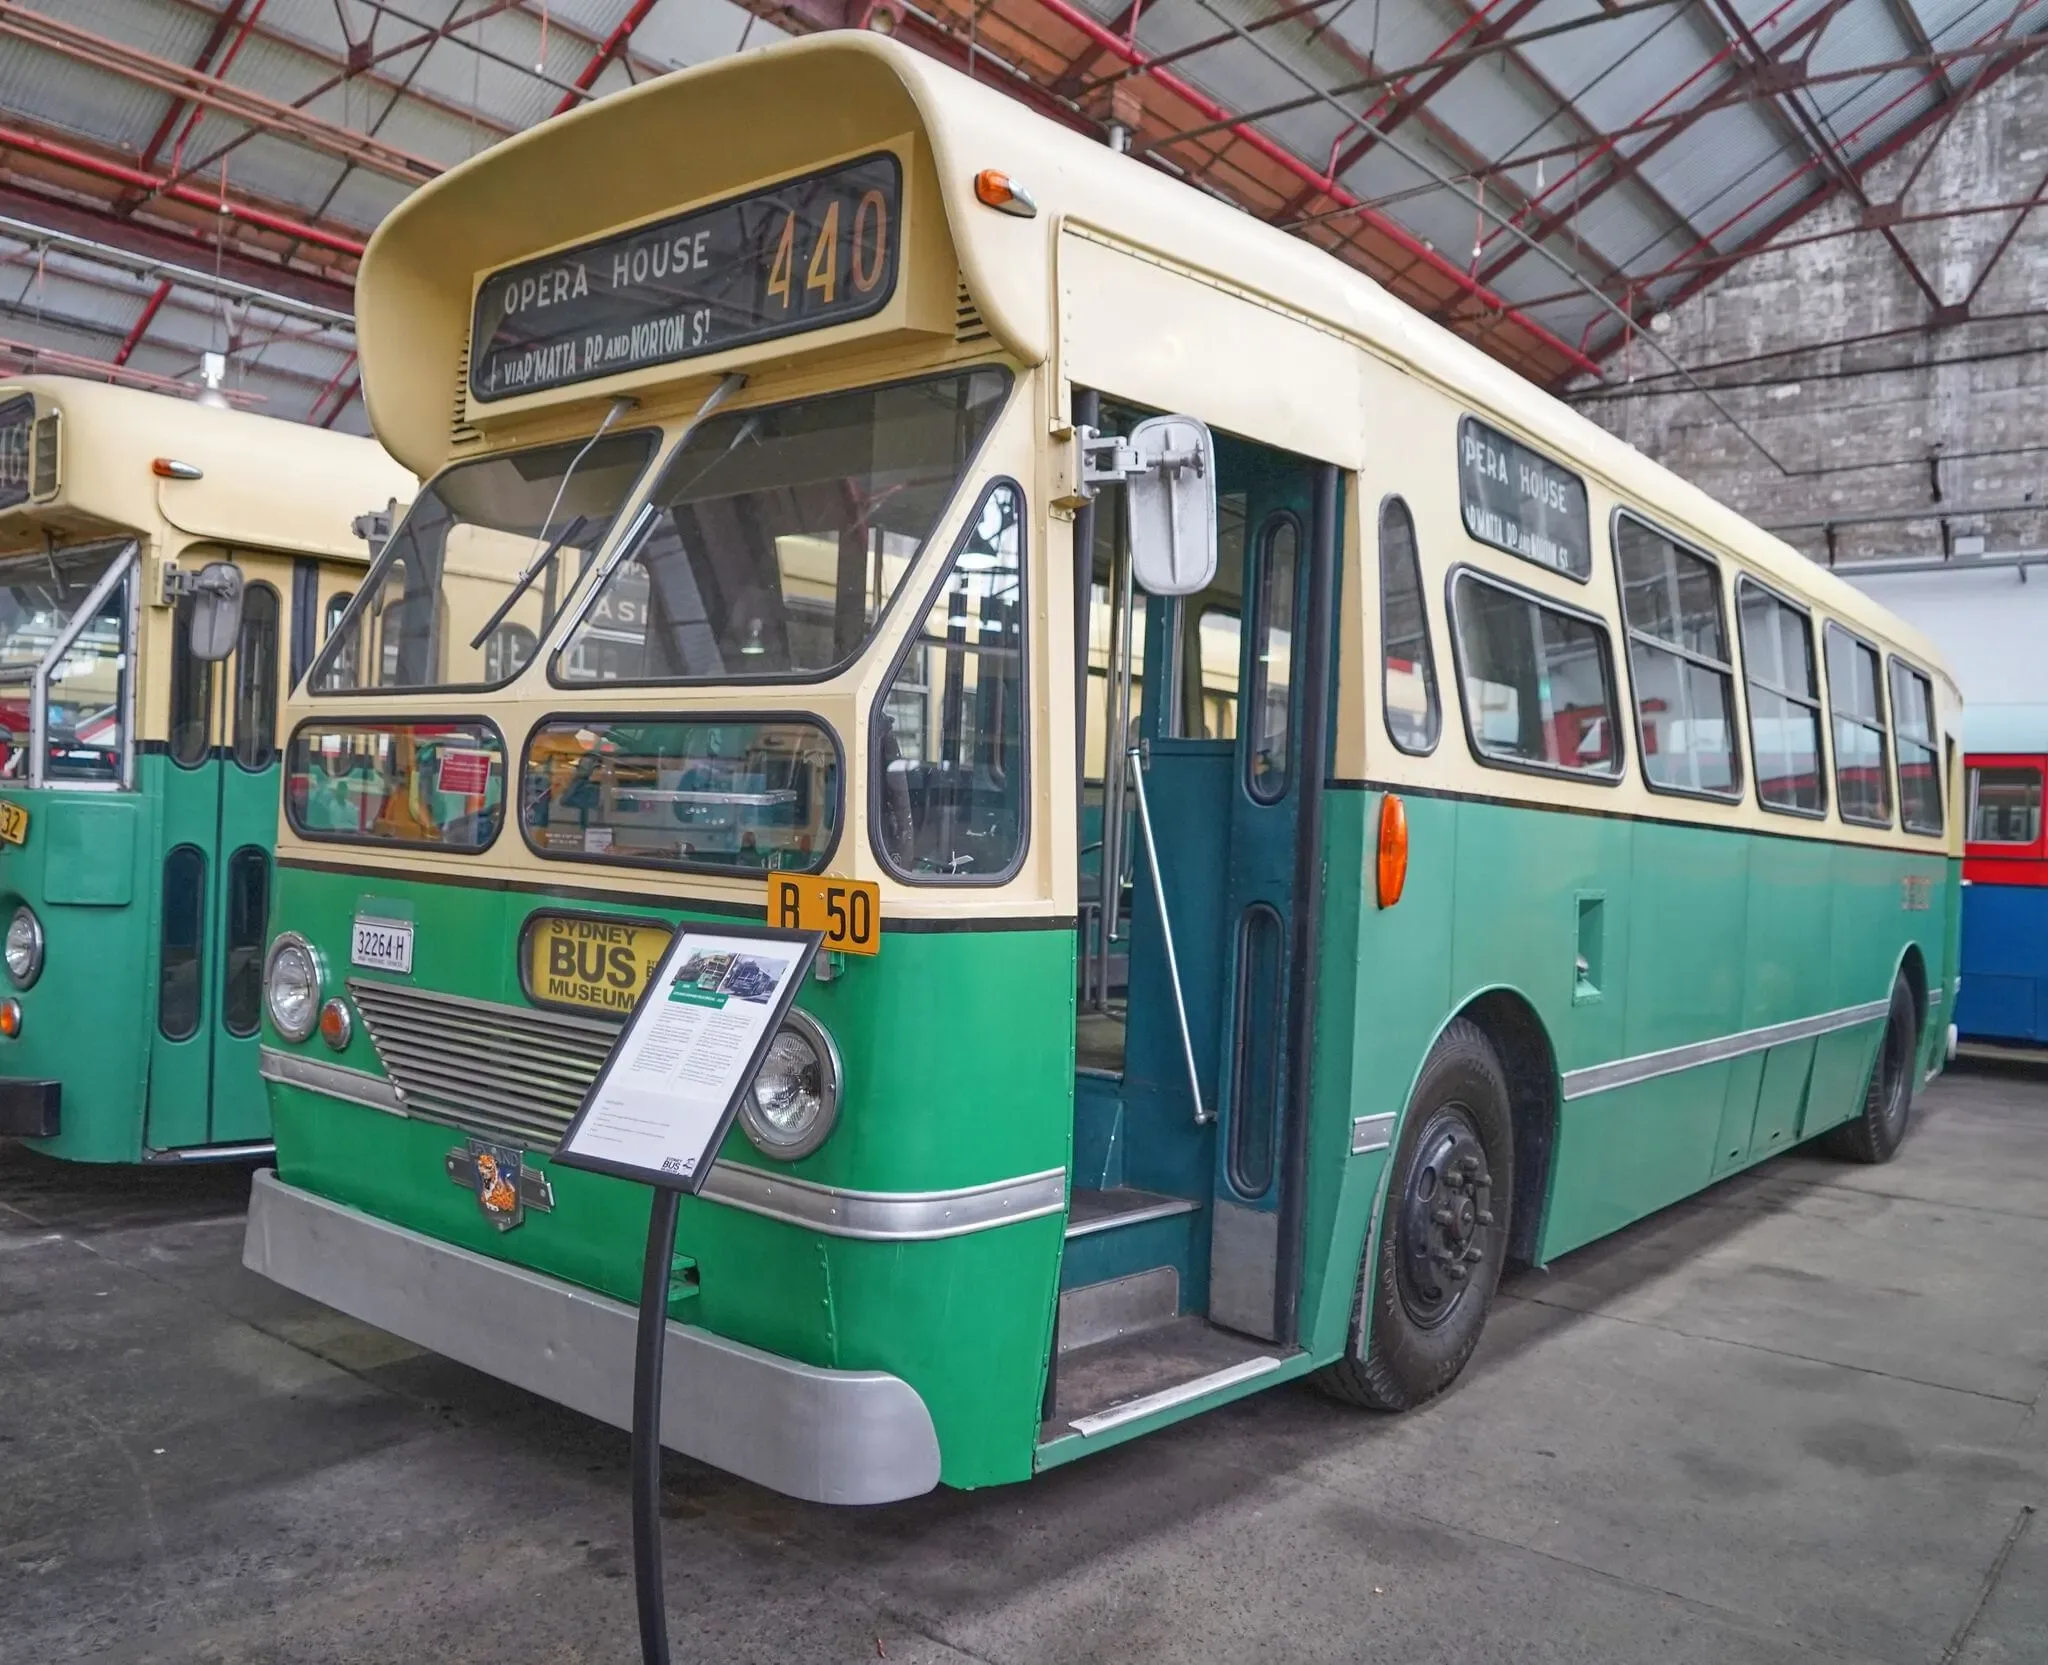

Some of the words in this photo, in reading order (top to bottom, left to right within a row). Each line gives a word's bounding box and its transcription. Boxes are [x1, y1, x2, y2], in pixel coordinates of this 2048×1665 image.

[504, 264, 589, 315] OPERA
[613, 230, 711, 289] HOUSE
[767, 189, 888, 309] 440
[604, 335, 630, 361] AND
[630, 314, 685, 360] NORTON
[1520, 464, 1568, 513] HOUSE
[551, 918, 638, 946] SYDNEY
[827, 888, 870, 944] 50
[549, 936, 636, 989] BUS
[549, 978, 636, 1009] MUSEUM
